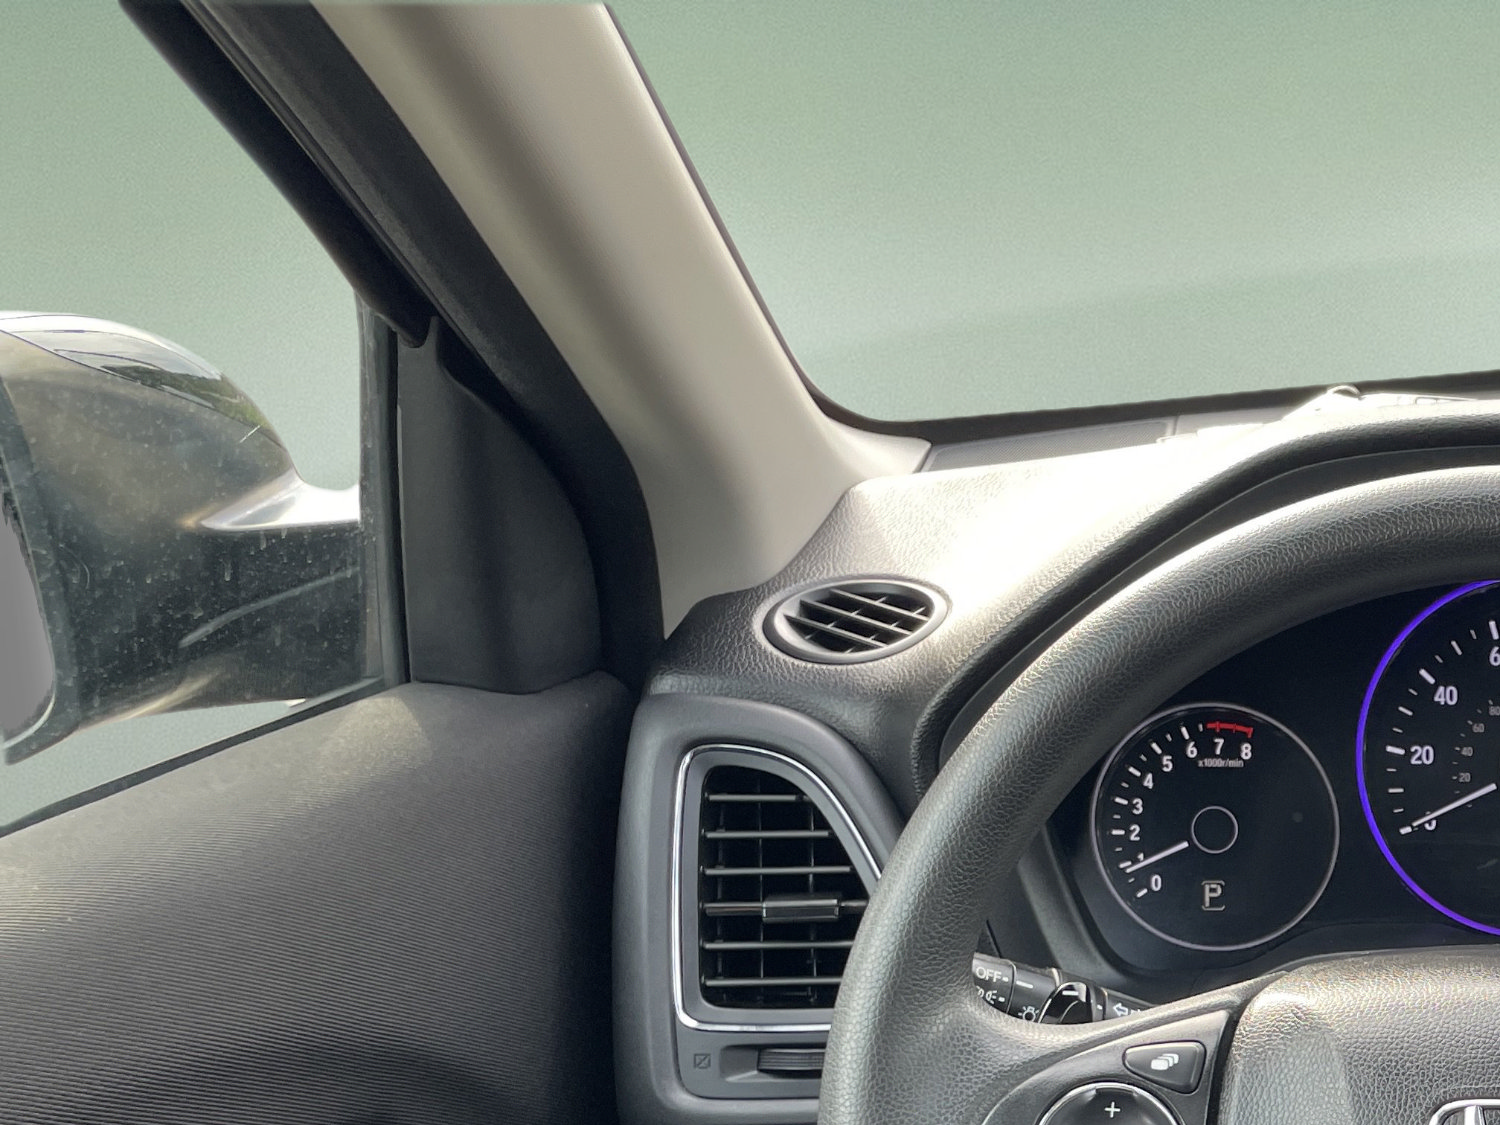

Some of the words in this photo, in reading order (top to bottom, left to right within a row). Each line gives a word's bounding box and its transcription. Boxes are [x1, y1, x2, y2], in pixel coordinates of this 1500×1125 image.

[1434, 685, 1458, 706] 40
[1472, 722, 1485, 733] 60
[1186, 740, 1198, 759] 6
[1213, 737, 1225, 755] 7
[1240, 742, 1253, 760] 8
[1410, 745, 1435, 765] 20
[1162, 755, 1174, 772] 5
[1143, 773, 1155, 789] 4
[1458, 771, 1471, 783] 20
[1132, 797, 1144, 815] 3
[1128, 823, 1141, 842] 2
[1151, 873, 1162, 892] 0
[1204, 883, 1222, 908] P
[975, 966, 1002, 983] OFF
